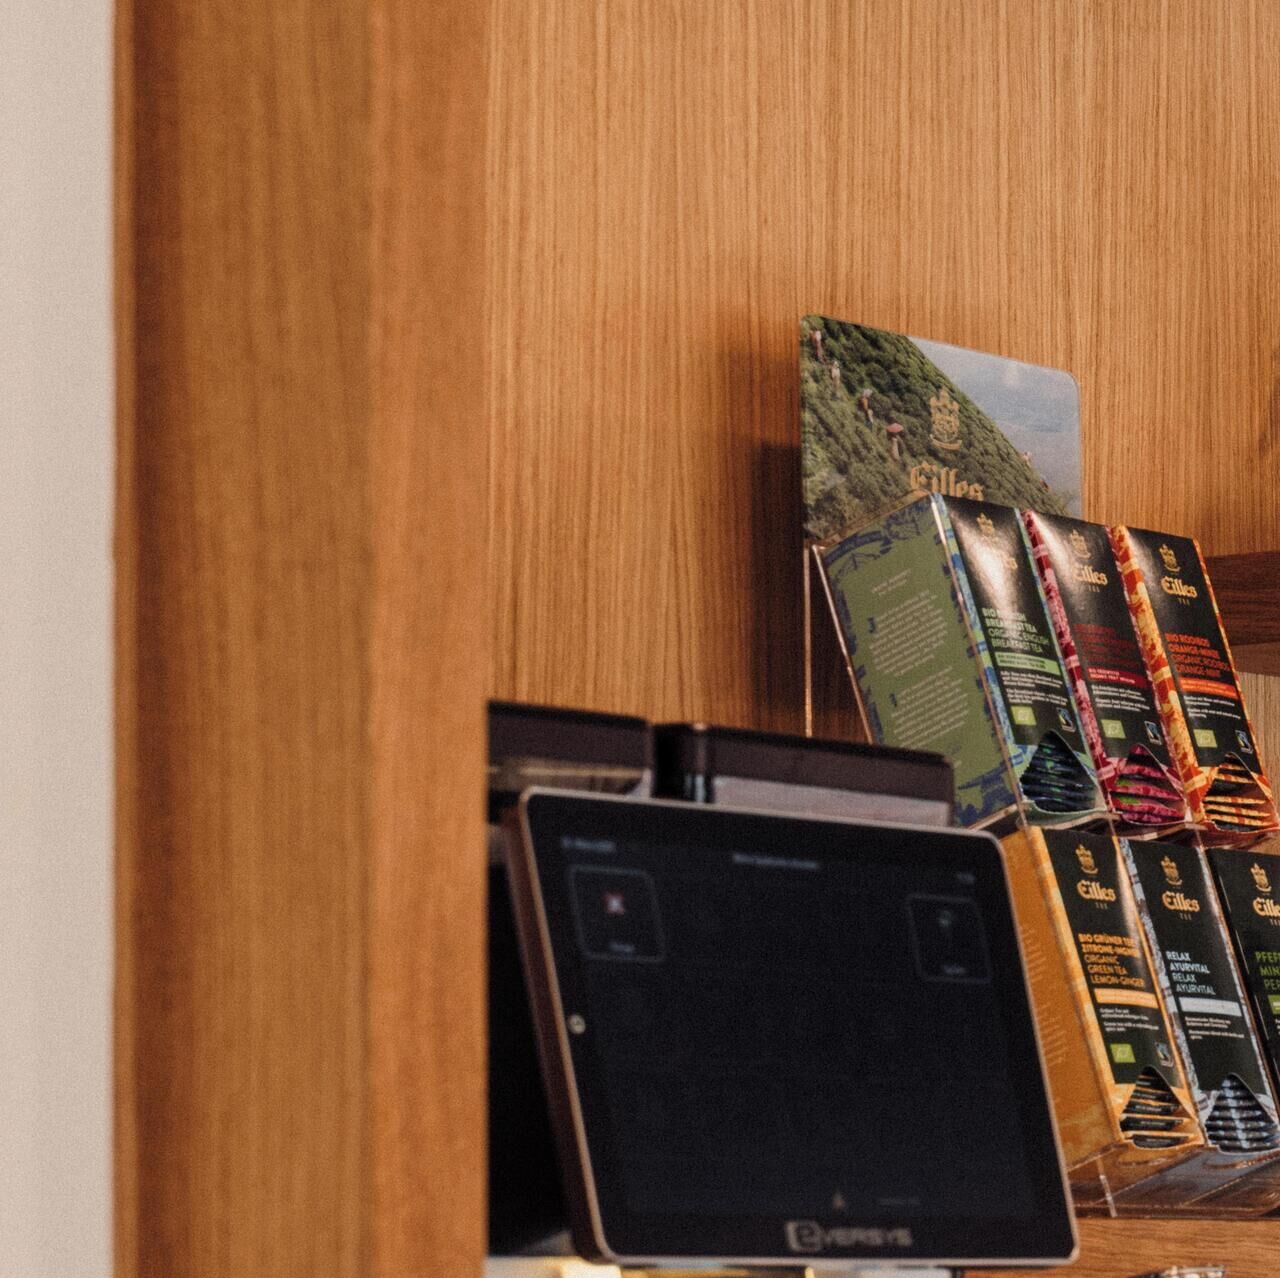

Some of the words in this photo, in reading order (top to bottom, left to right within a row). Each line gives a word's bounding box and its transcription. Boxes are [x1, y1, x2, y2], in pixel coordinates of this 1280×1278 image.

[1161, 576, 1198, 598] Eilles
[1076, 879, 1117, 902] Eilles
[1162, 890, 1200, 912] Eilles
[1165, 950, 1192, 961] RELAX
[1088, 964, 1114, 974] GREEN
[1114, 965, 1128, 976] TEA
[1169, 961, 1211, 975] AYURVITAL
[1171, 972, 1198, 983] RELAX
[1175, 983, 1217, 996] AYURVITAL
